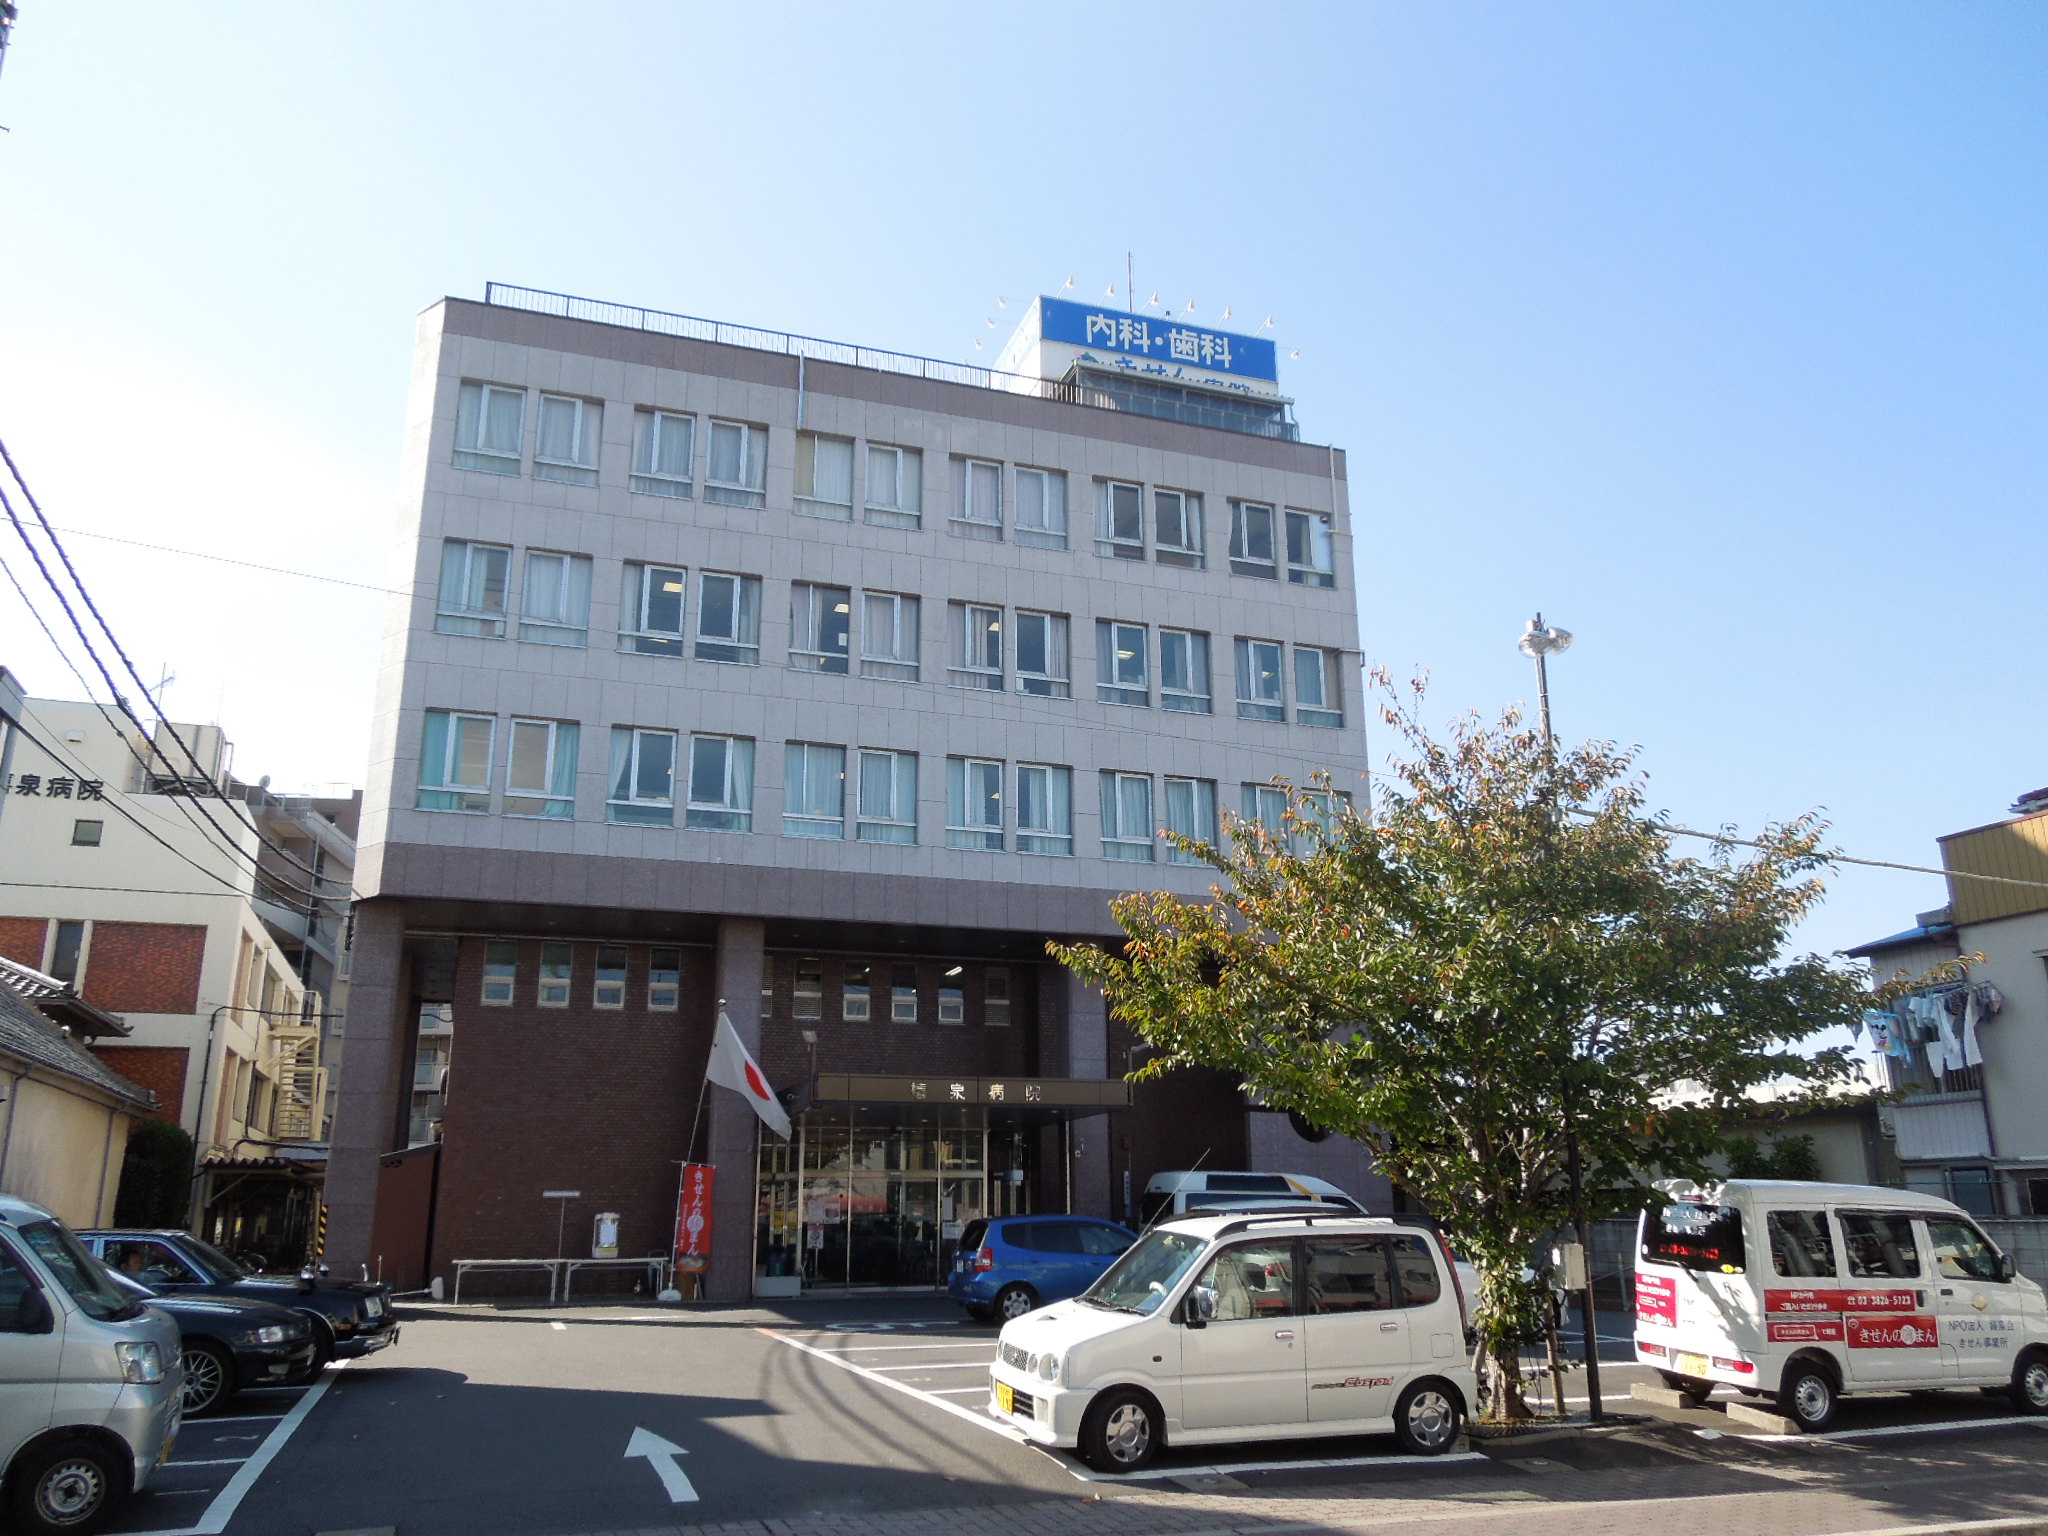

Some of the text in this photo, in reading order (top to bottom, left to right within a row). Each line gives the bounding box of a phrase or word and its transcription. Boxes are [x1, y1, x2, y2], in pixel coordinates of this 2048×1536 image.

[1086, 313, 1232, 369] 内科・歯科
